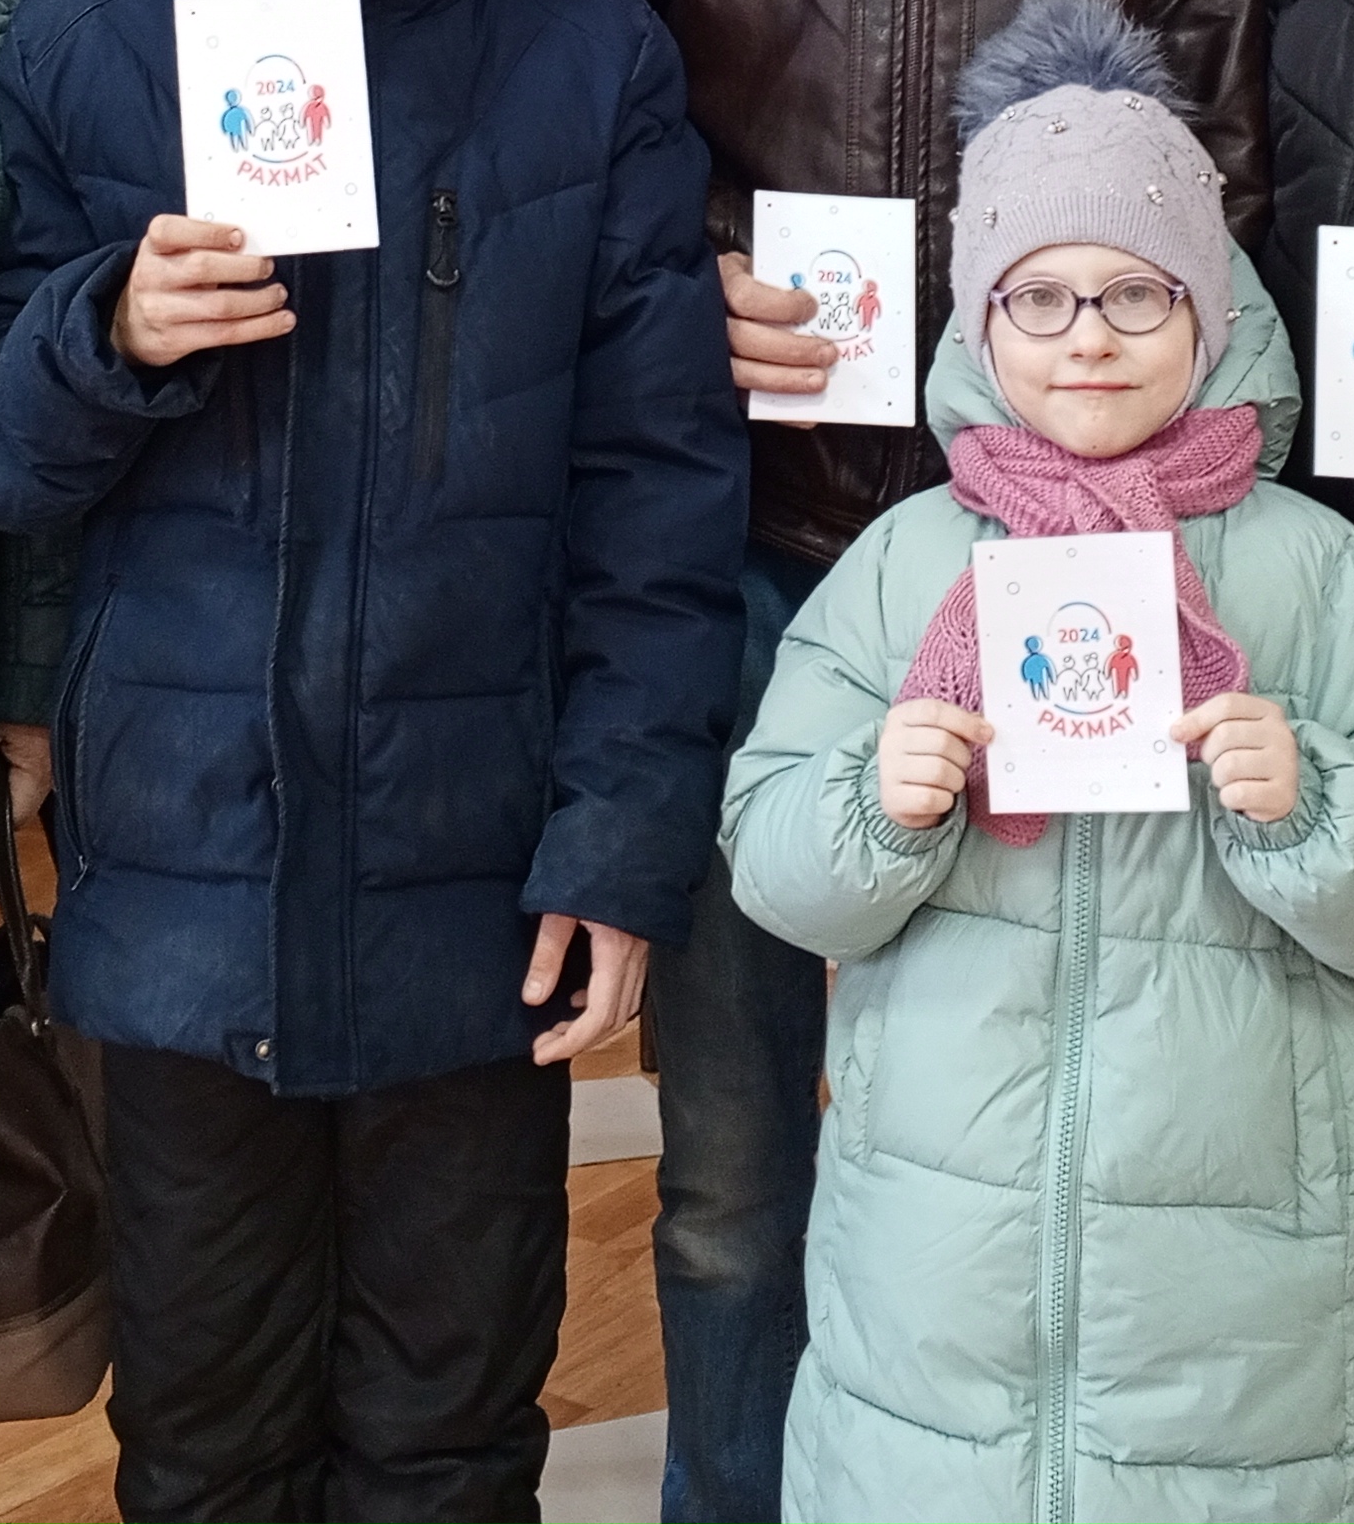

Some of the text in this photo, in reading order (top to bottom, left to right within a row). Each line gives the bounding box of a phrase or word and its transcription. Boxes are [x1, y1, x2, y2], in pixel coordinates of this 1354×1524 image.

[256, 79, 296, 96] 2024
[237, 152, 328, 187] РАХМАТ
[818, 270, 852, 285] 2024
[838, 338, 876, 362] МАТ
[1058, 628, 1101, 644] 2024
[1038, 706, 1135, 739] РАХМАТ
